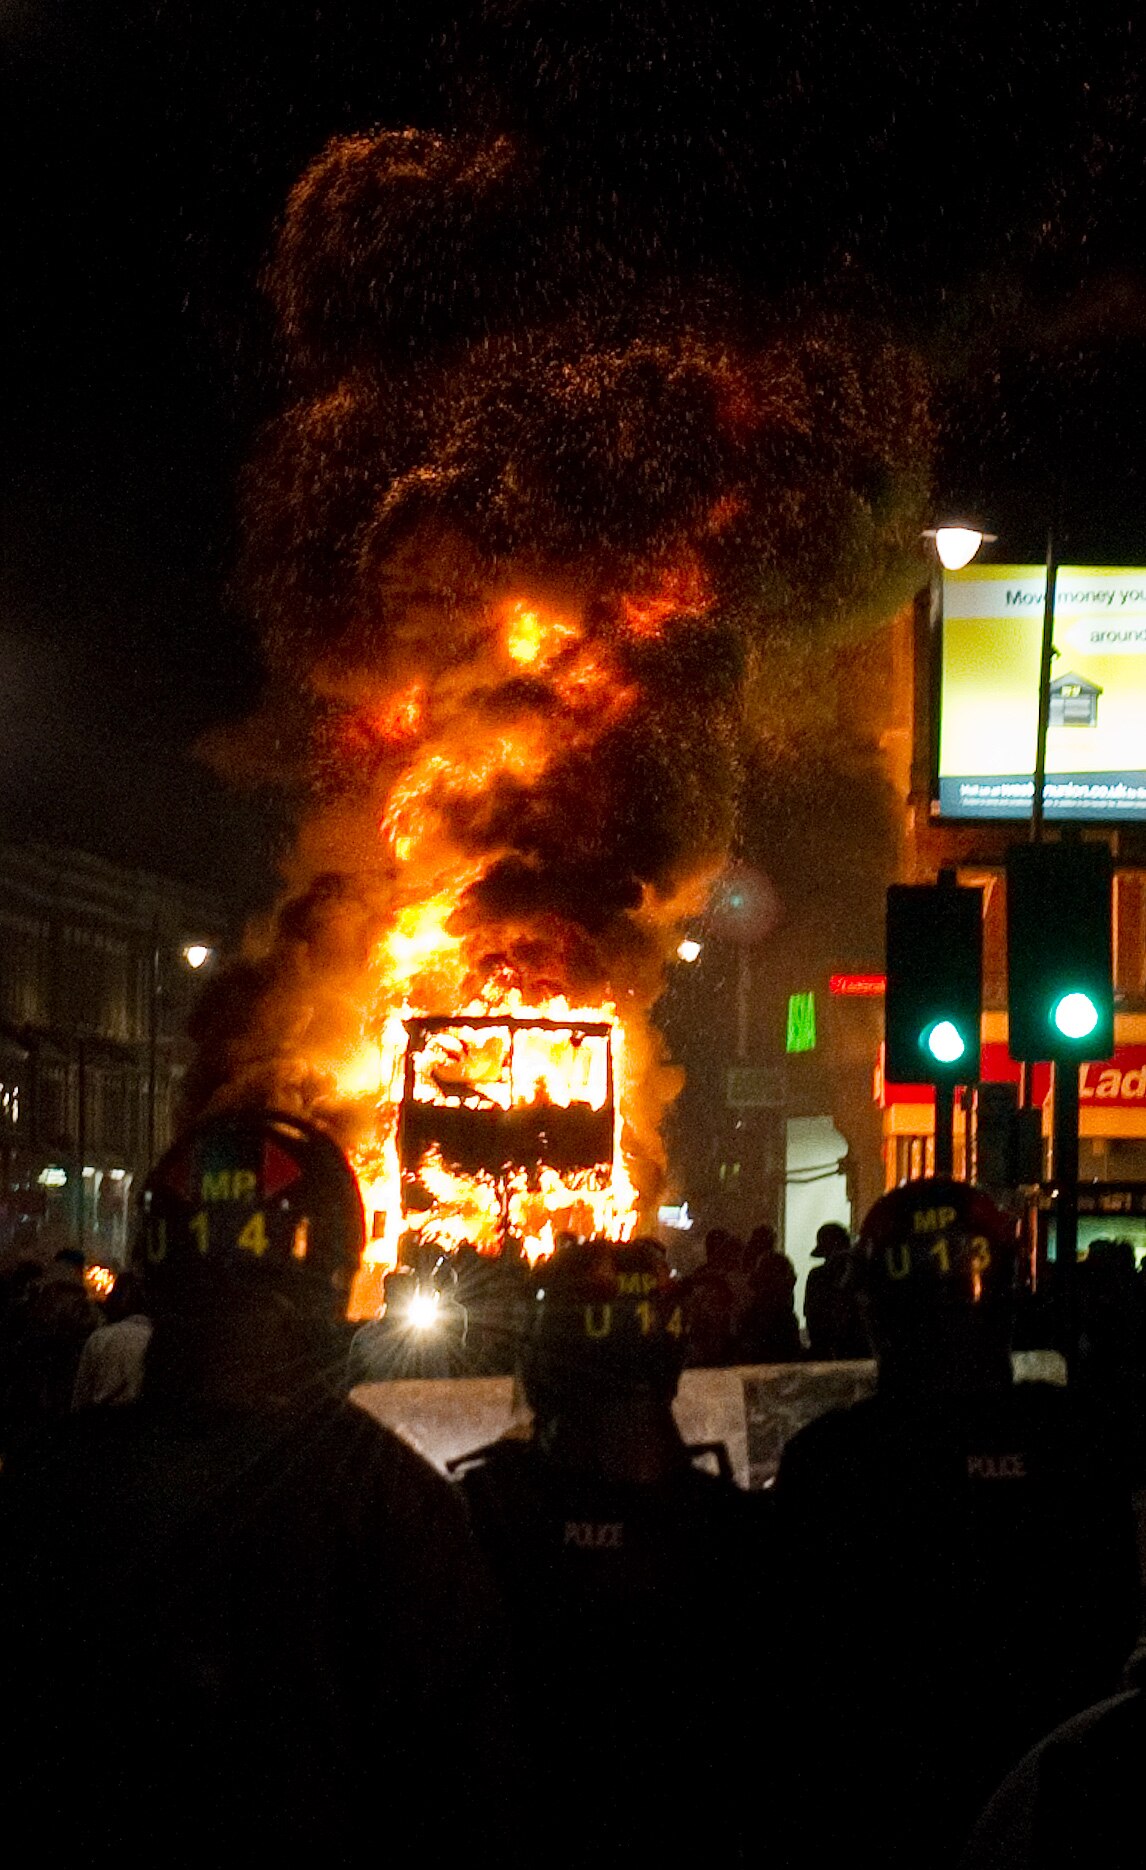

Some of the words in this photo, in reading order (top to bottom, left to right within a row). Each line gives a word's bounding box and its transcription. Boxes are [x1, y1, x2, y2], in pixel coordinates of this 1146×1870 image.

[1006, 589, 1046, 606] Mov
[1058, 590, 1115, 606] money
[1078, 1062, 1146, 1099] Lad
[200, 1168, 257, 1202] MP
[911, 1205, 958, 1234] MP
[967, 1453, 1025, 1479] POLICE
[563, 1521, 625, 1549] POLICE
